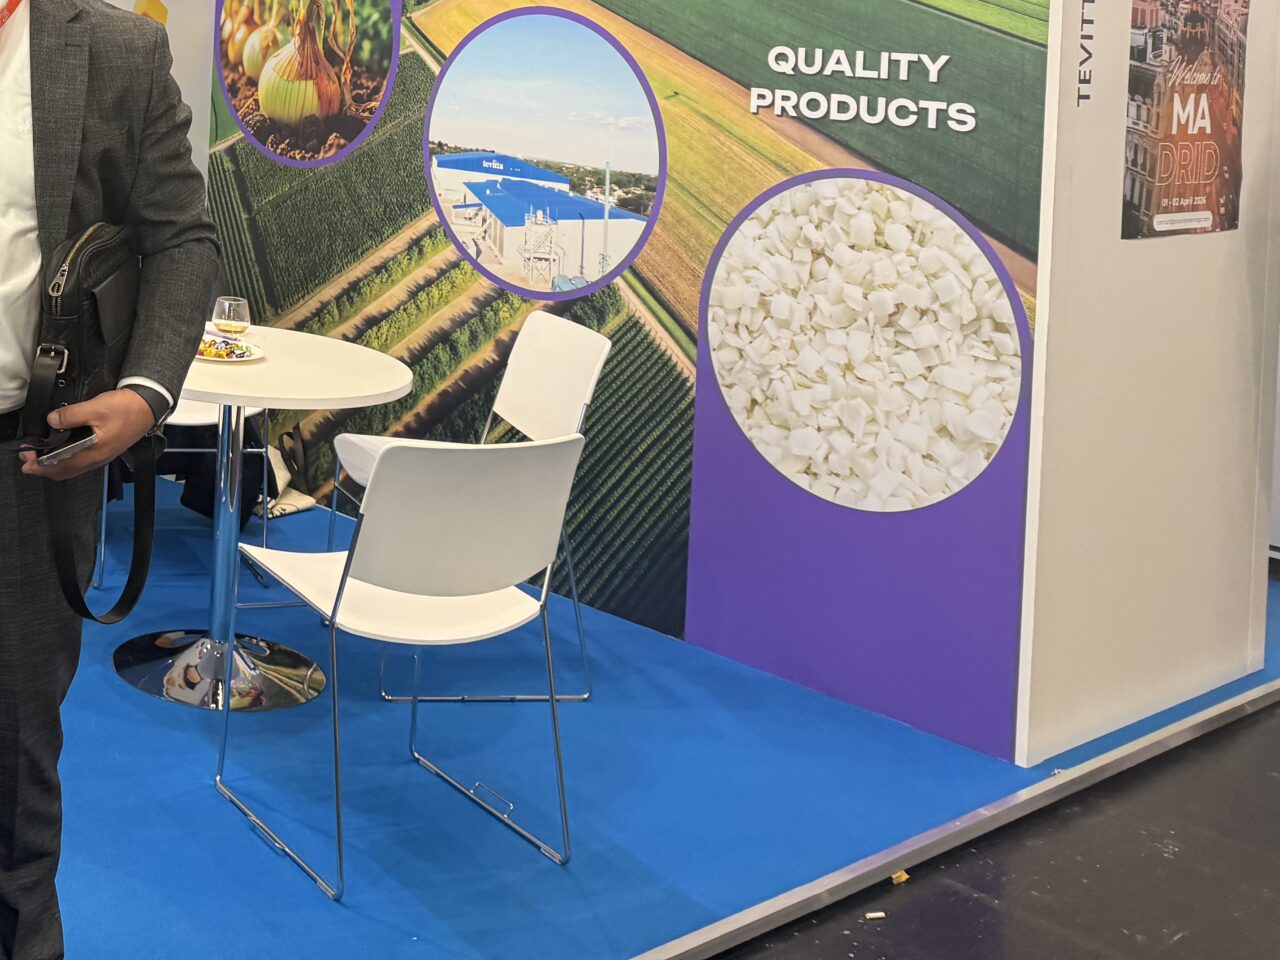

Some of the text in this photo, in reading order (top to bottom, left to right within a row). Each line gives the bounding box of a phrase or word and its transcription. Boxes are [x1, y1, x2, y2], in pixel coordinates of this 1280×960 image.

[768, 45, 951, 83] QUALITY
[1169, 55, 1222, 88] Welcome to
[749, 86, 977, 133] PRODUCTS
[1171, 93, 1212, 135] MA
[1156, 141, 1220, 186] DRID
[1180, 197, 1193, 207] April
